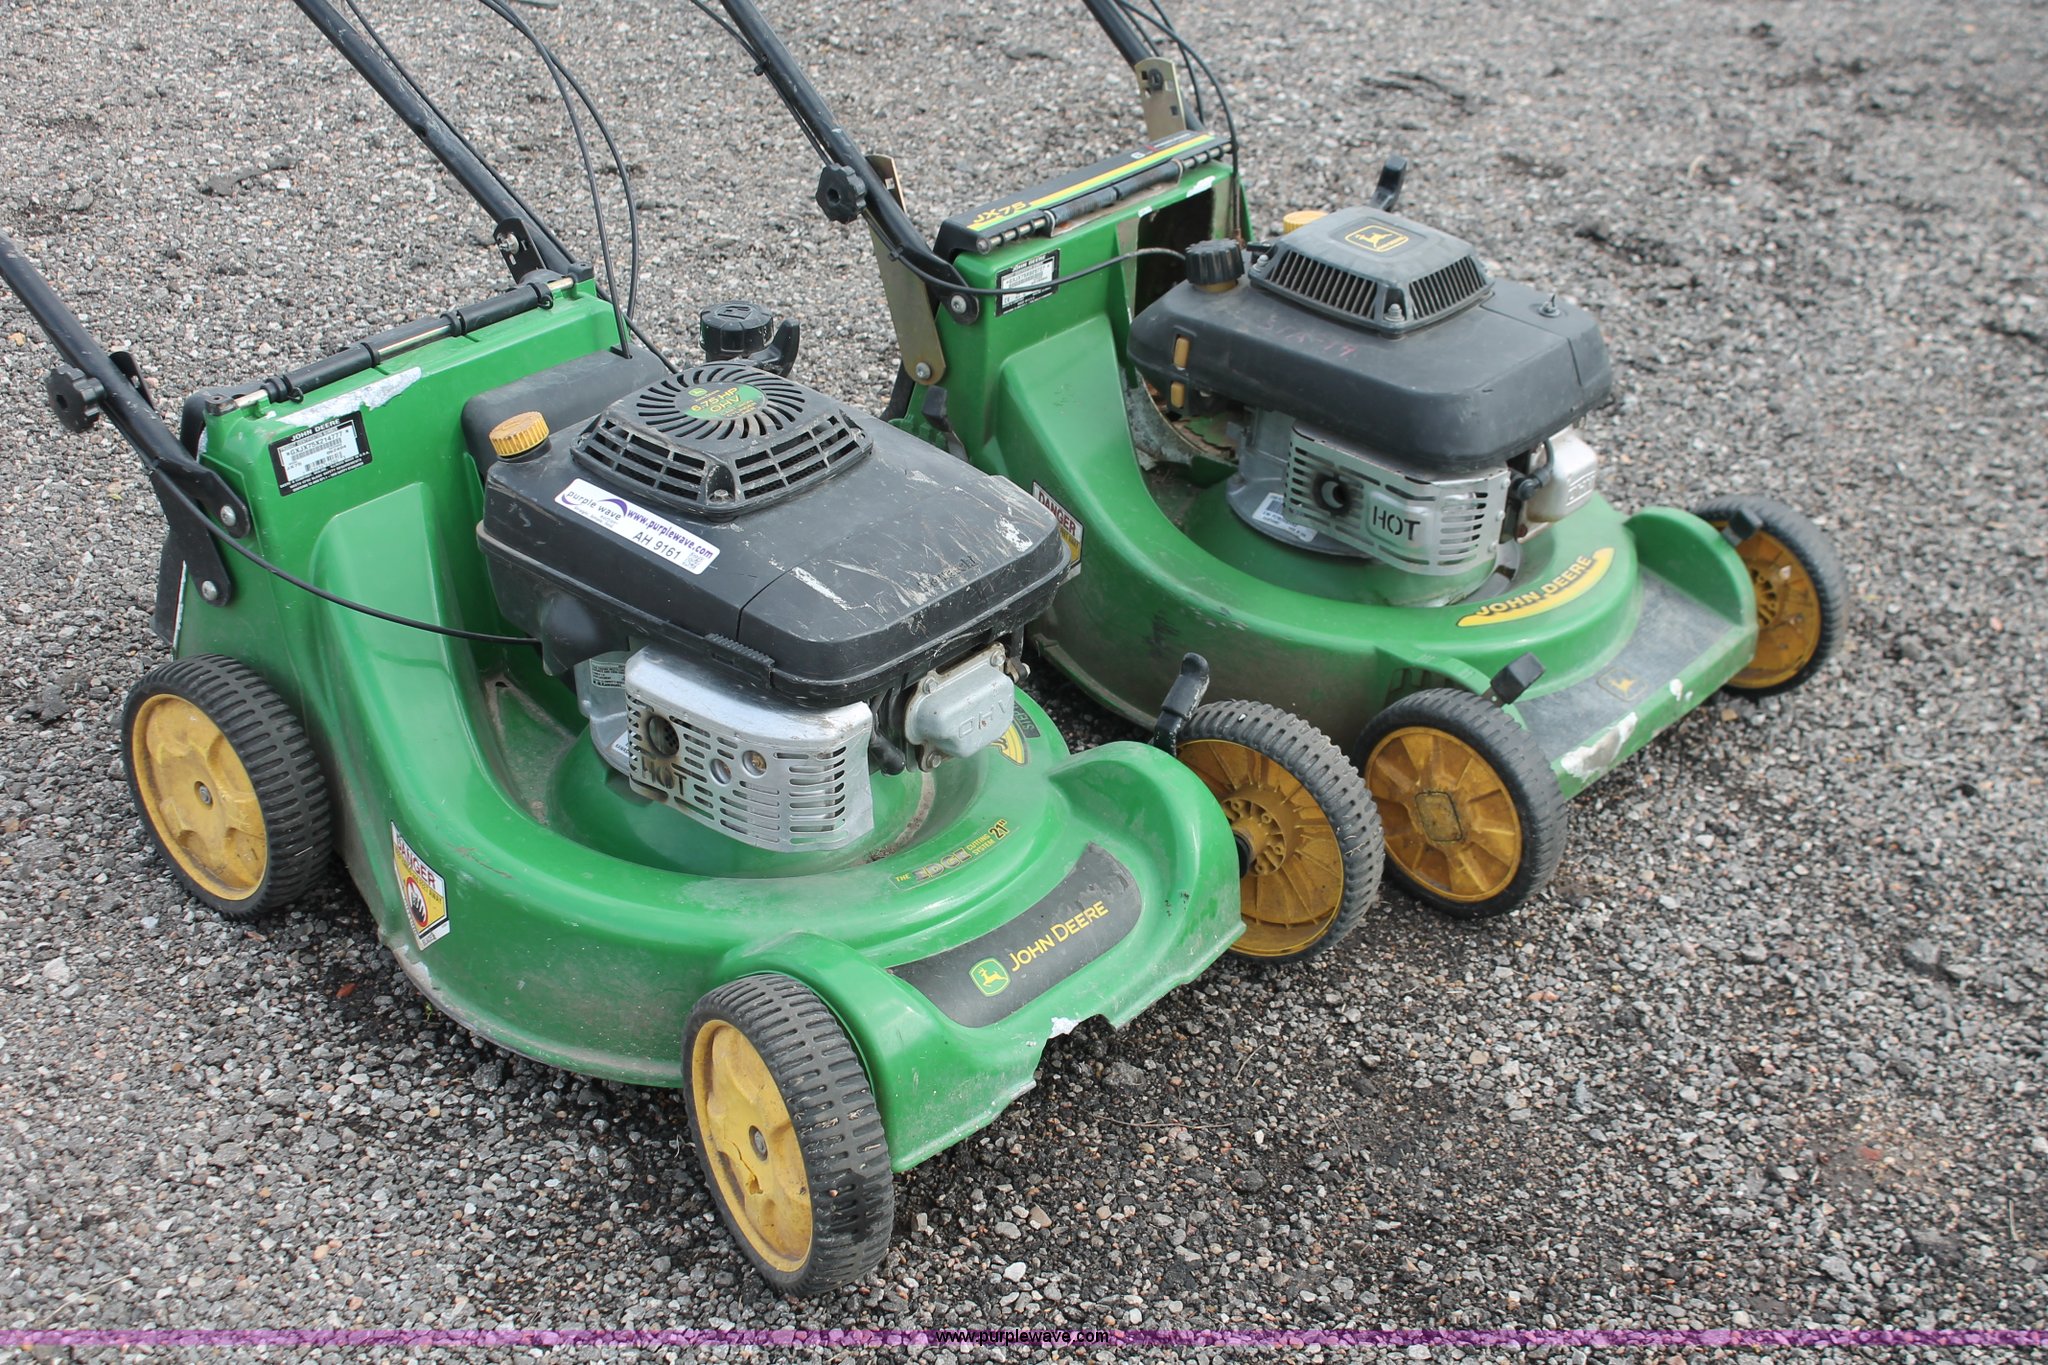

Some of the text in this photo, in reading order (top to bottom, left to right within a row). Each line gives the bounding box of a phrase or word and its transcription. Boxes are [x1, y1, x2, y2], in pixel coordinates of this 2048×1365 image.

[973, 201, 1027, 223] JX75
[691, 397, 720, 411] 6.75
[718, 387, 739, 399] HP
[710, 395, 740, 412] OHV
[291, 430, 313, 442] JOHN
[314, 419, 341, 432] DEERE
[566, 490, 596, 509] purple
[598, 504, 622, 521] wave
[1038, 491, 1077, 537] DANGER
[627, 509, 714, 559] www.purplewave.com
[1372, 505, 1421, 541] HOT
[633, 531, 682, 560] AH 9161
[1475, 555, 1593, 617] JOHN DEERE
[641, 756, 687, 796] HOT
[966, 834, 991, 851] CUTTING
[972, 838, 996, 856] SYSTEM
[396, 833, 436, 890] DANGER
[895, 873, 911, 882] THE
[1008, 900, 1109, 972] JOHN DEERE
